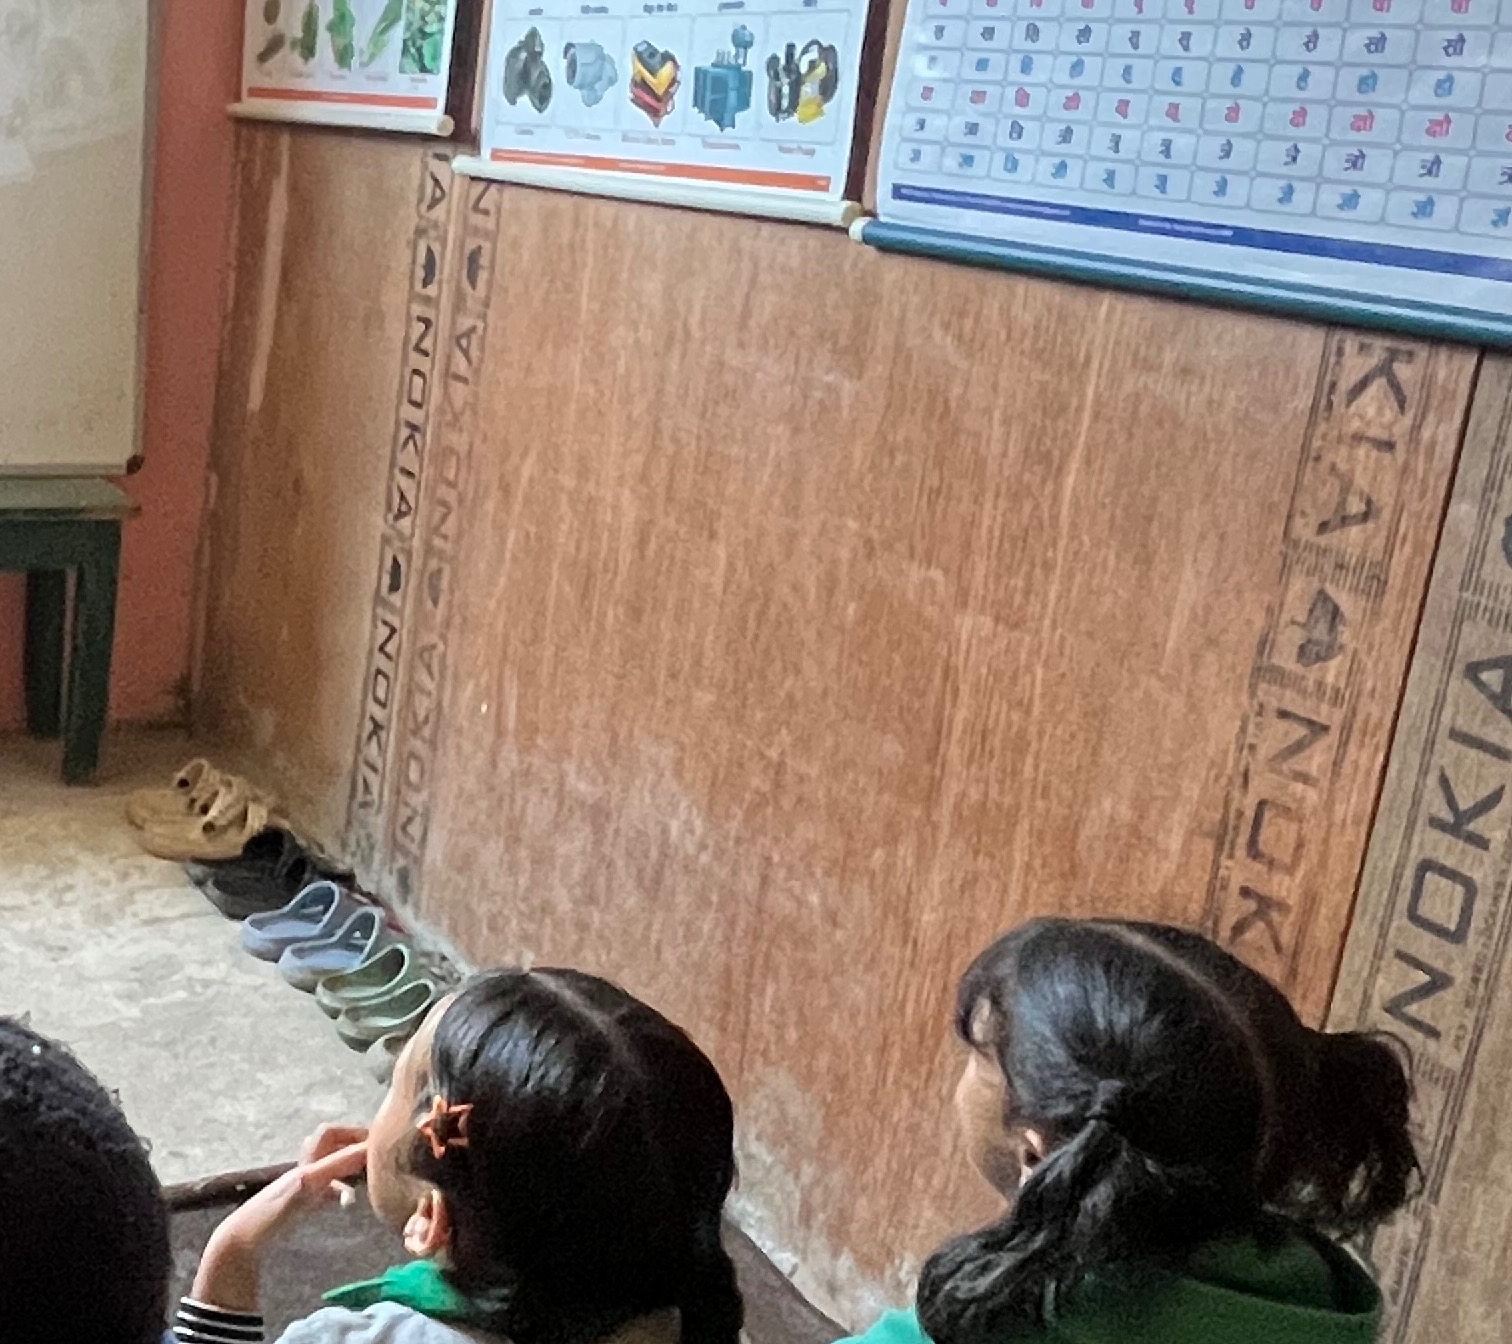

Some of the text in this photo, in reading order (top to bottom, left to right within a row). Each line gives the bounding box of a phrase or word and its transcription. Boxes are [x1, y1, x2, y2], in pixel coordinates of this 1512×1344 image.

[390, 314, 434, 525] NOKIA
[1316, 342, 1416, 538] KIA
[1227, 704, 1333, 957] NOK
